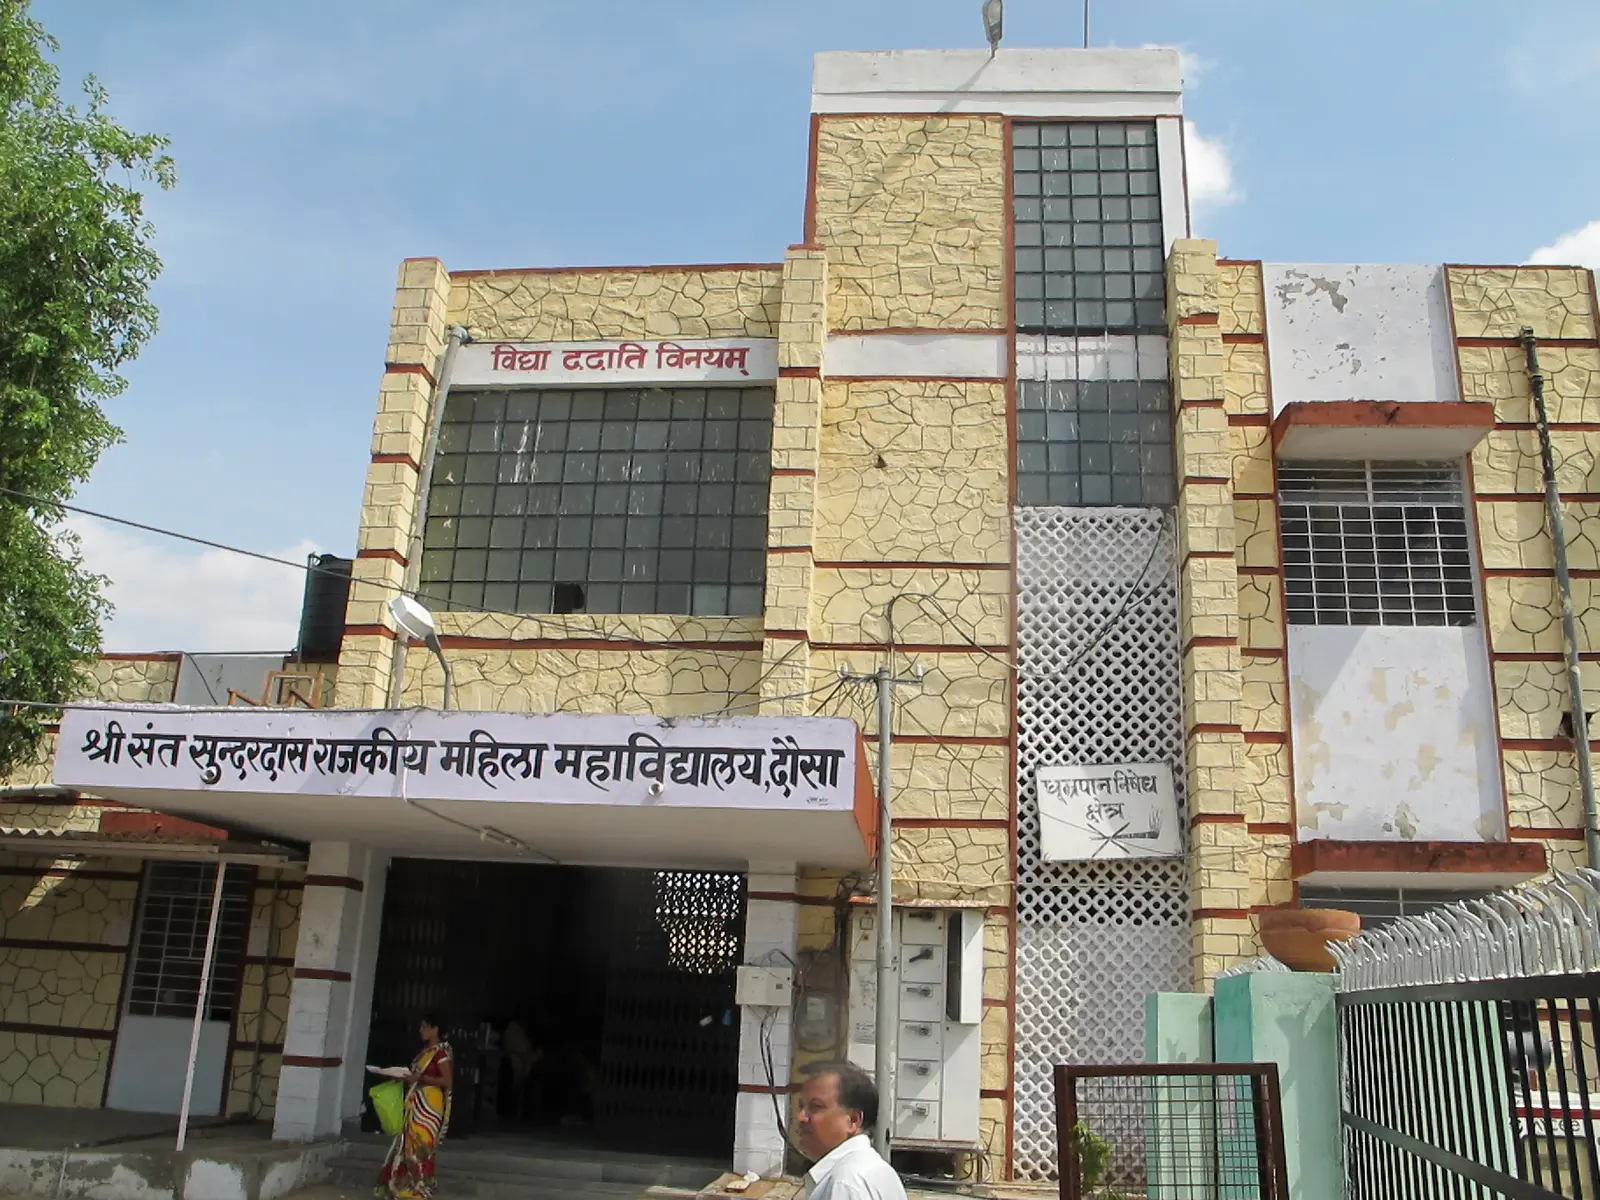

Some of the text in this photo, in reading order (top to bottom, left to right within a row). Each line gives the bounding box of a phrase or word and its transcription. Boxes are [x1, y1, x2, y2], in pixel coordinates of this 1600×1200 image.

[491, 342, 750, 376] विद्या ददाति विनयम्
[81, 720, 126, 764] श्री
[127, 722, 187, 768] संत
[189, 733, 313, 784] सुन्दरदास
[314, 726, 436, 776] राजकीय
[440, 729, 548, 789] महिला
